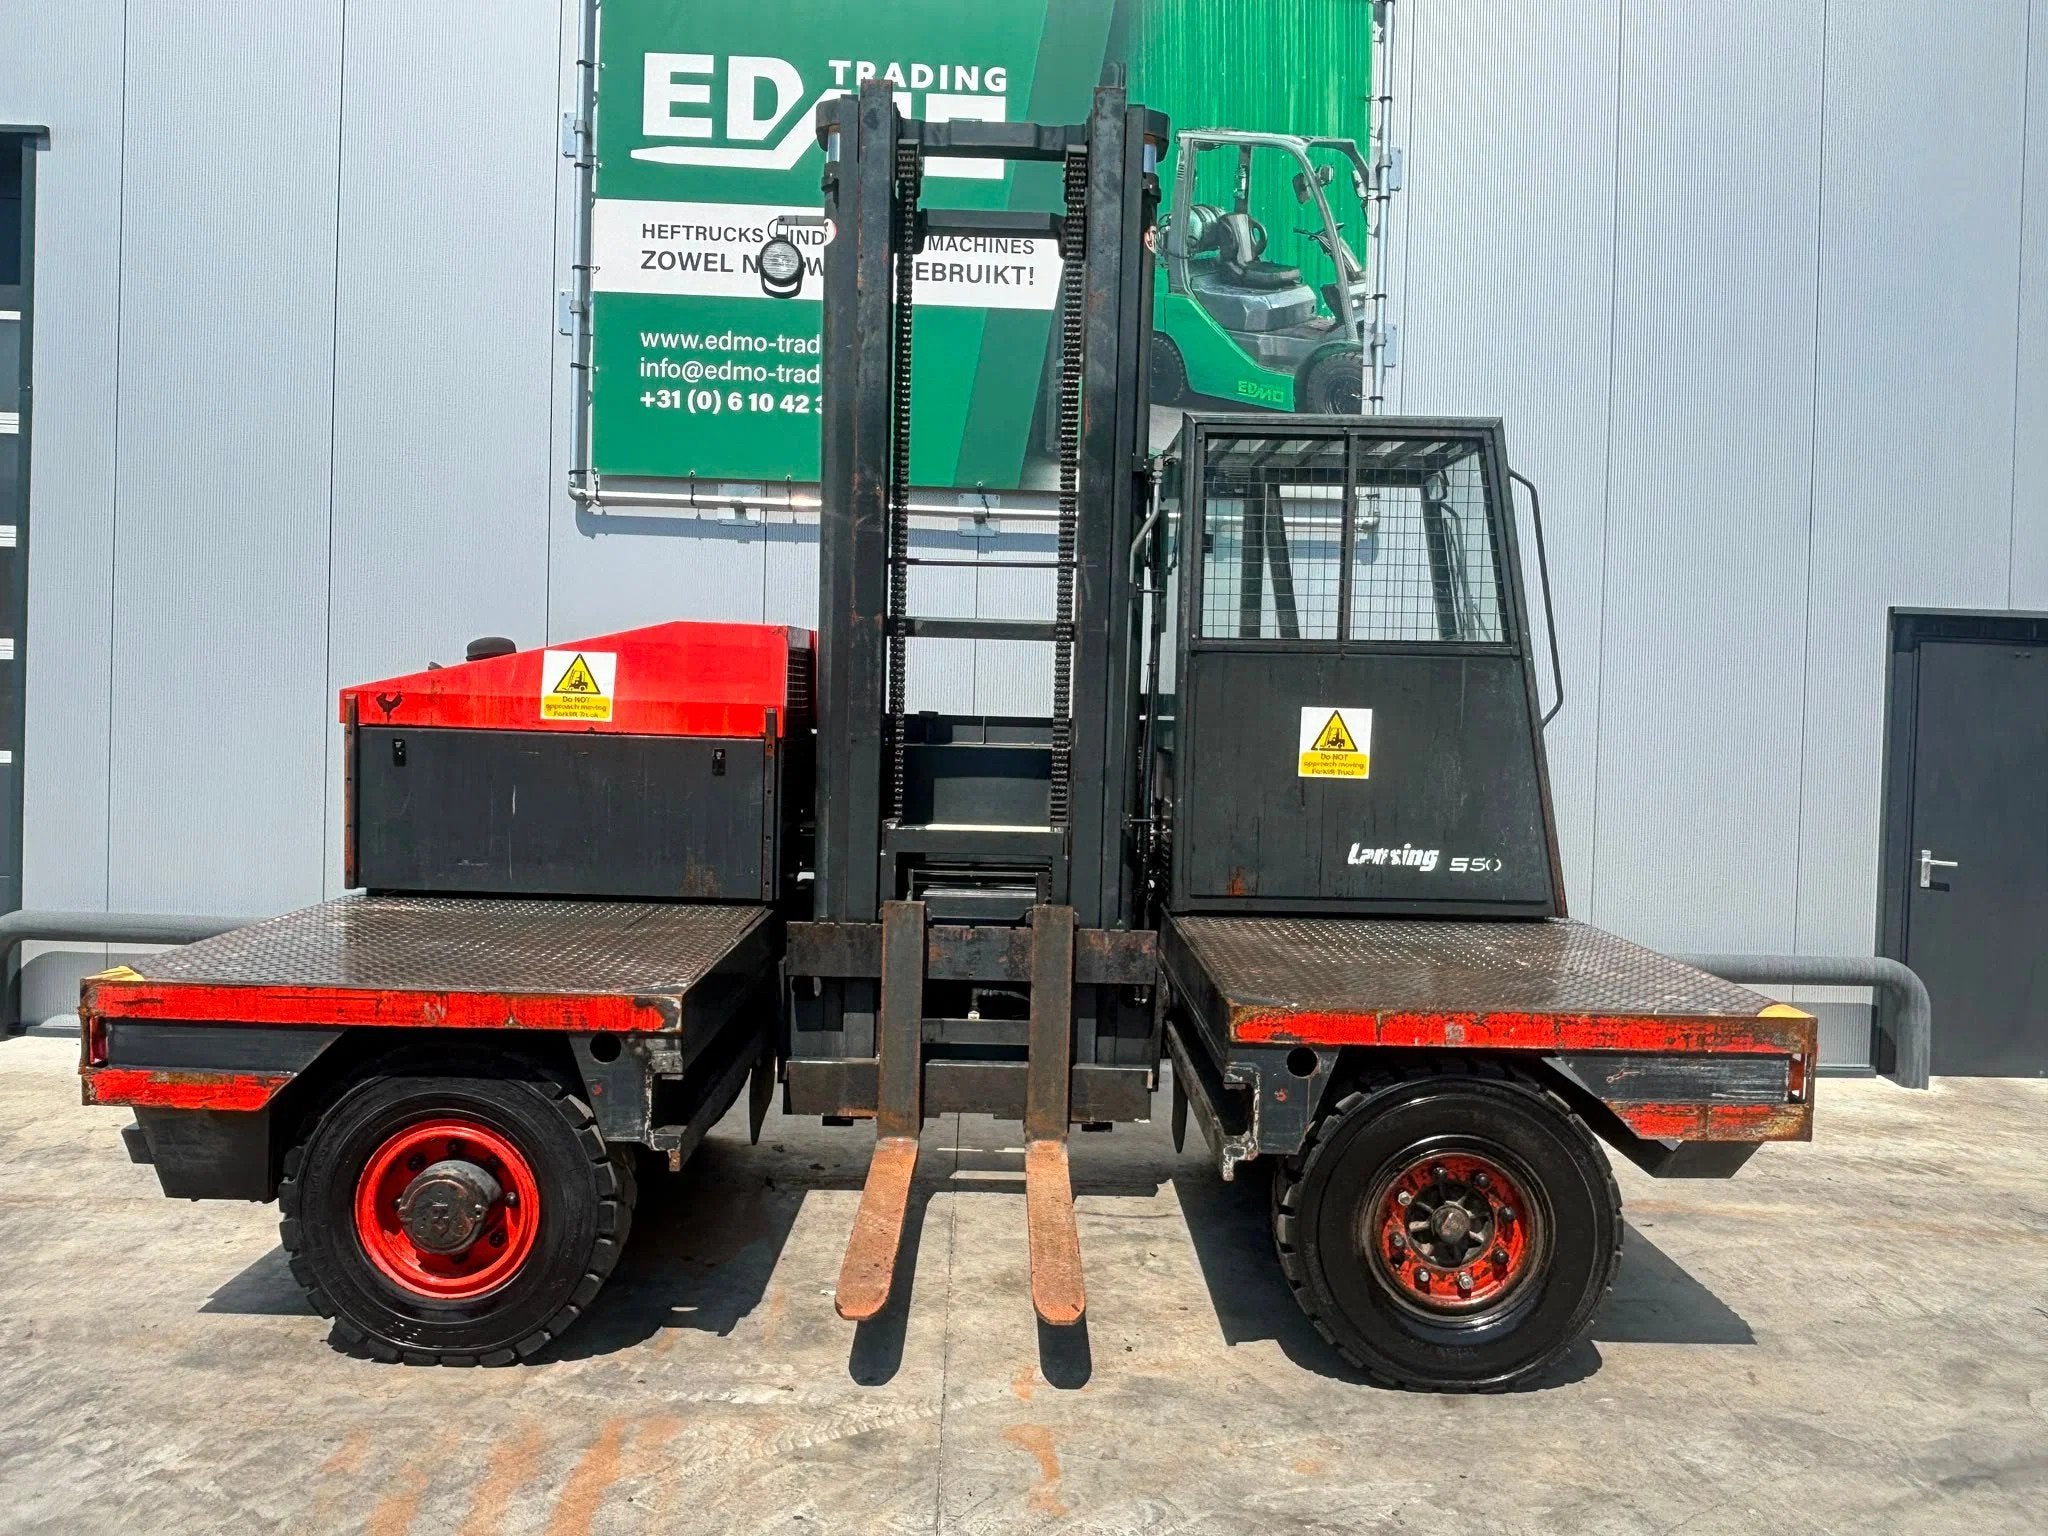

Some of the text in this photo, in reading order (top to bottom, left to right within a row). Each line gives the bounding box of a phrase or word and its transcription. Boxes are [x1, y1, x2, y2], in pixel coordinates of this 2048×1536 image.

[828, 59, 1007, 92] TRADING
[641, 223, 764, 243] HEFTRUCKS
[928, 236, 1035, 254] MACHINES
[640, 250, 734, 273] ZOWEL
[915, 261, 1034, 285] EBRUIKT!
[640, 331, 821, 354] www.edmo-trad
[640, 357, 821, 384] info@edmo-trad
[640, 389, 681, 409] +31
[687, 389, 722, 414] (0)
[727, 393, 743, 411] 6
[748, 393, 774, 412] 10
[779, 394, 810, 414] 42
[1238, 380, 1284, 403] EDMO
[580, 704, 607, 712] moving
[1332, 753, 1349, 761] NOT
[1338, 762, 1365, 770] moving
[1347, 842, 1440, 872] Lansing
